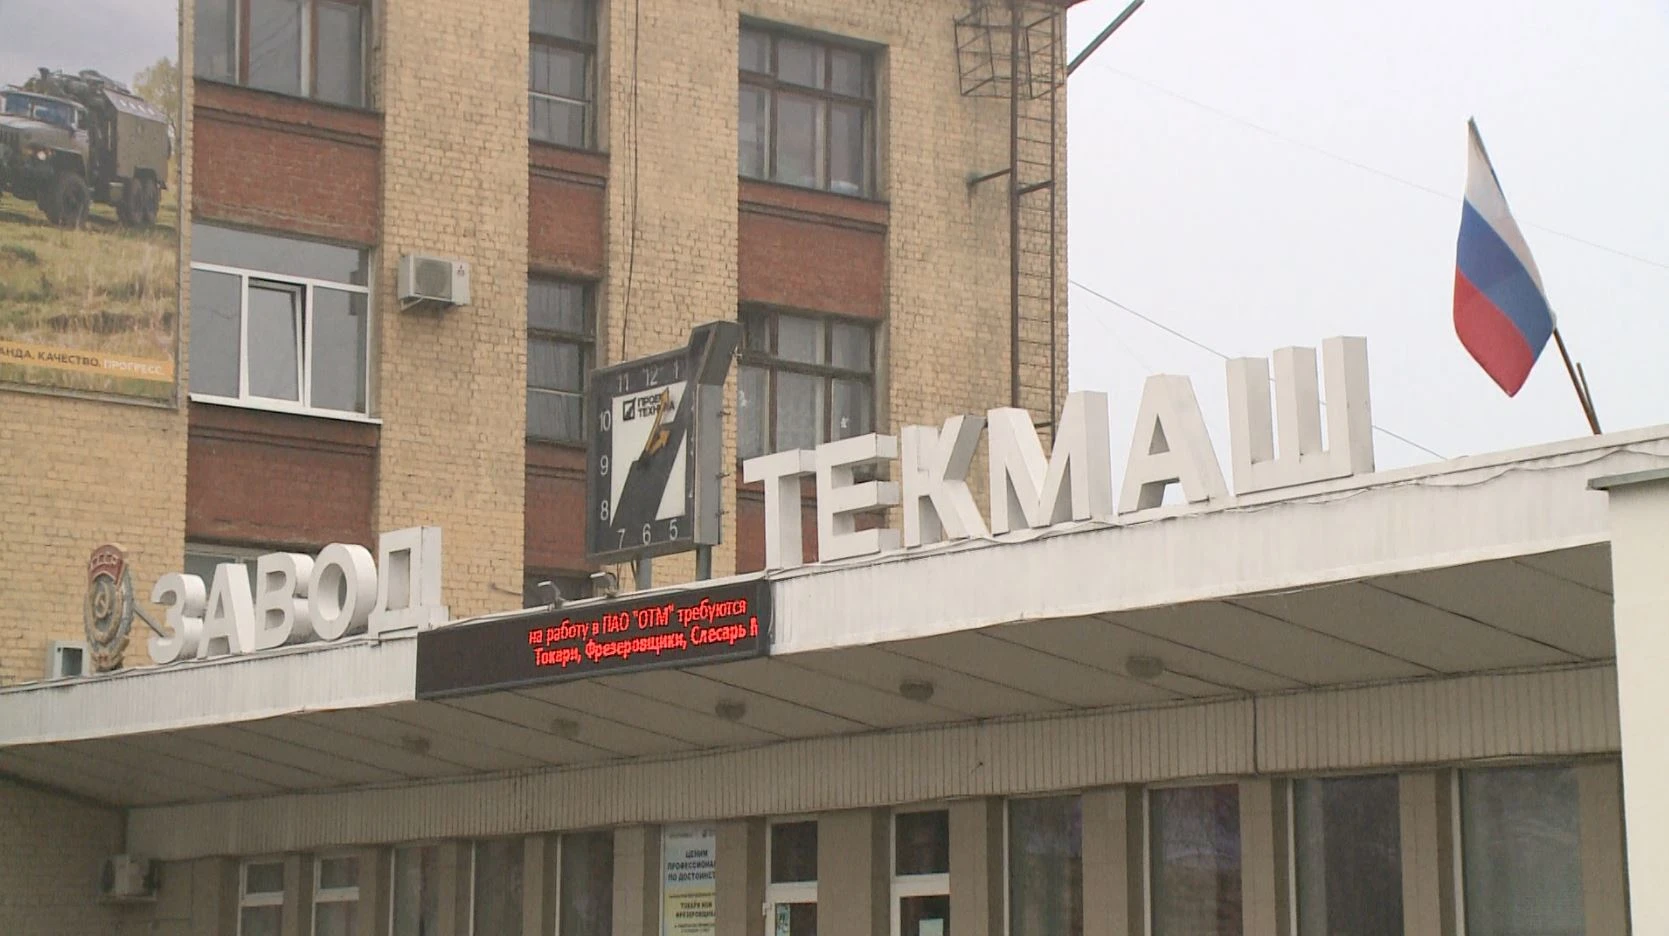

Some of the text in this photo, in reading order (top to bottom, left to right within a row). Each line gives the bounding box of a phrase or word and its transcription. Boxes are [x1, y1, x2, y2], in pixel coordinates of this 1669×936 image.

[618, 374, 630, 392] 11
[644, 369, 658, 386] 12
[600, 411, 611, 432] 10
[600, 456, 609, 475] 9
[743, 336, 1375, 571] ТЕКМАШ
[600, 501, 609, 521] 8
[617, 519, 678, 549] 7 6 5
[148, 526, 450, 664] ЗАВОД
[529, 630, 543, 645] на
[546, 618, 589, 645] работу
[592, 622, 599, 634] в
[603, 611, 630, 634] ПАО
[633, 604, 674, 629] "ОТМ"
[677, 598, 747, 627] требуются
[534, 647, 582, 667] Токари,
[585, 632, 687, 662] Фрезеровщики,
[690, 623, 747, 645] Слесарь
[685, 849, 708, 859] ЦЕНИМ
